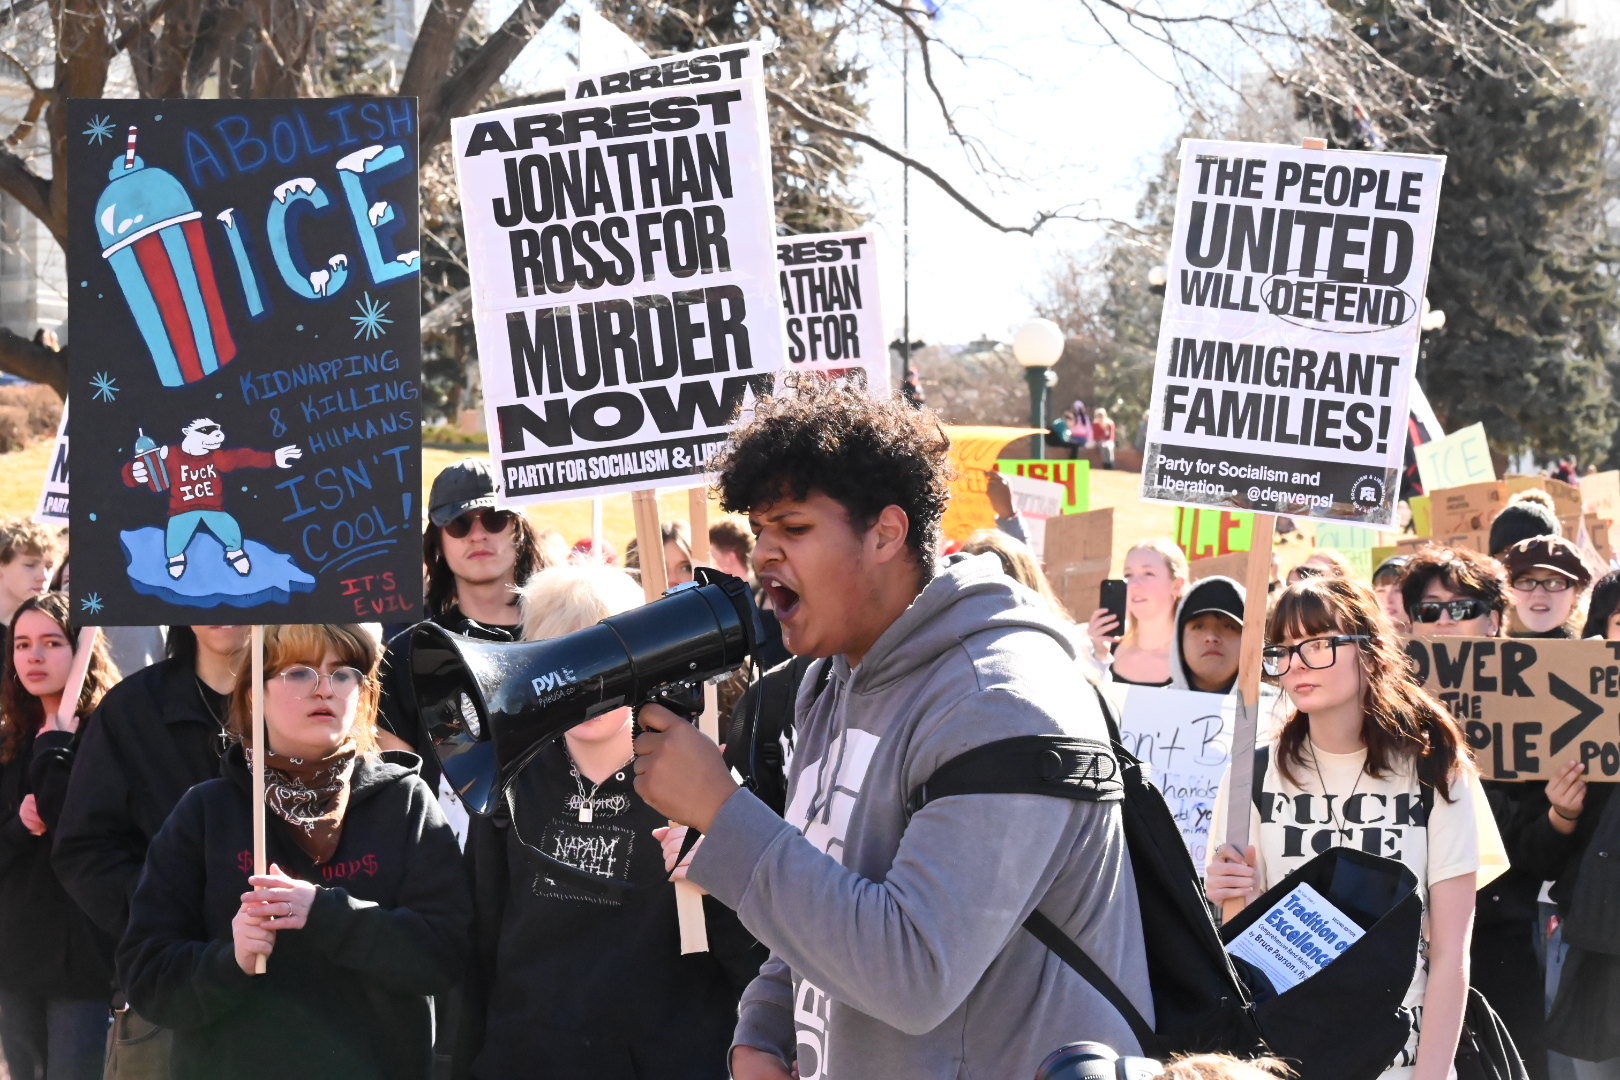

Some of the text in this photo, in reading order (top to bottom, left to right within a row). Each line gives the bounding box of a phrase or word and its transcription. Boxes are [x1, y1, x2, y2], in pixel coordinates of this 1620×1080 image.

[575, 48, 750, 100] ARREST
[184, 102, 413, 182] ABOLISH
[465, 89, 743, 157] ARREST
[493, 131, 734, 228] JONATHAN
[1195, 154, 1424, 214] THE PEOPLE
[217, 144, 420, 317] ICE
[509, 204, 732, 299] ROSS FOR
[1184, 200, 1415, 287] UNITED
[1180, 268, 1406, 327] WILL DEFEND
[505, 284, 754, 399] MURDER
[807, 313, 861, 362] FOR
[239, 349, 401, 404] KIDNAPPING
[1166, 337, 1400, 398] IMMIGRANT
[270, 381, 419, 438] & KILLING
[308, 411, 414, 454] HUMANS
[1162, 384, 1392, 454] FAMILIES!
[179, 464, 217, 482] FUCK
[275, 446, 411, 524] ISN'T
[507, 463, 558, 490] PARTY
[556, 458, 589, 484] FOR
[588, 449, 670, 480] SOCIALISM
[672, 447, 693, 469] &
[1156, 454, 1321, 487] Party for Socialism and
[1428, 437, 1487, 489] ICE
[179, 479, 215, 501] ICE
[1153, 475, 1334, 508] Liberation @denverpsl
[303, 492, 412, 562] COOL!
[339, 571, 397, 596] IT'S
[354, 593, 414, 617] EVIL
[531, 667, 577, 697] PYLE
[1438, 691, 1482, 720] THE
[1589, 665, 1620, 698] PE
[1579, 740, 1620, 777] PO
[1163, 772, 1219, 799] hands
[1260, 791, 1427, 828] FUCK
[552, 834, 620, 863] NAPALM
[1281, 825, 1403, 861] ICE
[1265, 908, 1334, 969] Excellence
[1283, 893, 1339, 945] Tradition
[1248, 930, 1256, 938] by
[1254, 933, 1275, 954] Bruce
[1271, 949, 1297, 972] Pearson
[1257, 922, 1313, 971] Comprehensive Band Method
